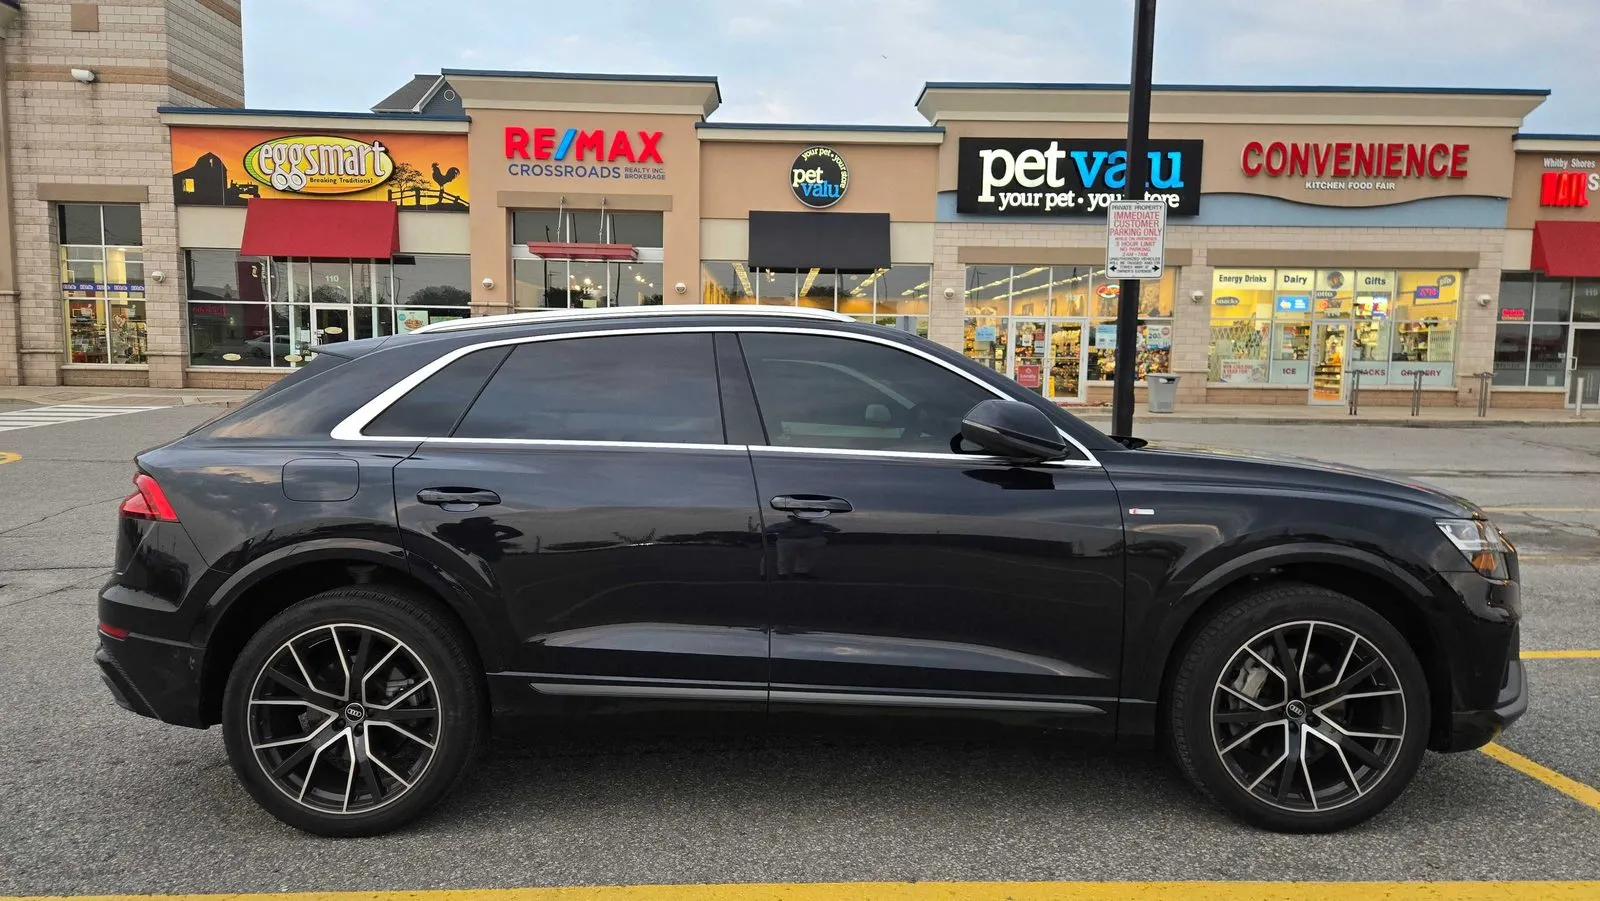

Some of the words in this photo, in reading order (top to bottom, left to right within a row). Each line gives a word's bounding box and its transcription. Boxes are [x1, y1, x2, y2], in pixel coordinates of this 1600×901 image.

[504, 126, 664, 163] RE/MAX
[1241, 141, 1470, 178] CONVENIENCE
[1543, 157, 1569, 169] Whitby
[1570, 158, 1596, 168] Shores
[258, 140, 386, 191] eggsmart
[508, 163, 621, 179] CROSSROADS
[977, 141, 1066, 203] pet
[1070, 150, 1184, 188] vau
[624, 173, 666, 181] BROKERAGE
[792, 167, 824, 188] pet
[800, 180, 840, 198] valu
[1305, 181, 1346, 190] KITCHEN
[1347, 181, 1373, 190] FOOD
[1375, 182, 1397, 190] FAIR
[998, 191, 1044, 212] your
[1044, 190, 1075, 212] pet
[1087, 191, 1126, 212] you
[1143, 190, 1180, 208] tore
[1113, 211, 1160, 219] IMMEDIATE
[1113, 219, 1160, 228] CUSTOMER
[1109, 228, 1142, 236] PARKING
[1143, 228, 1162, 236] ONLY
[325, 275, 340, 283] 110
[1219, 274, 1243, 284] Energy
[1244, 274, 1267, 283] Drinks
[1283, 275, 1308, 285] Dairy
[1364, 276, 1387, 285] Gifts
[1282, 367, 1297, 375] ICE
